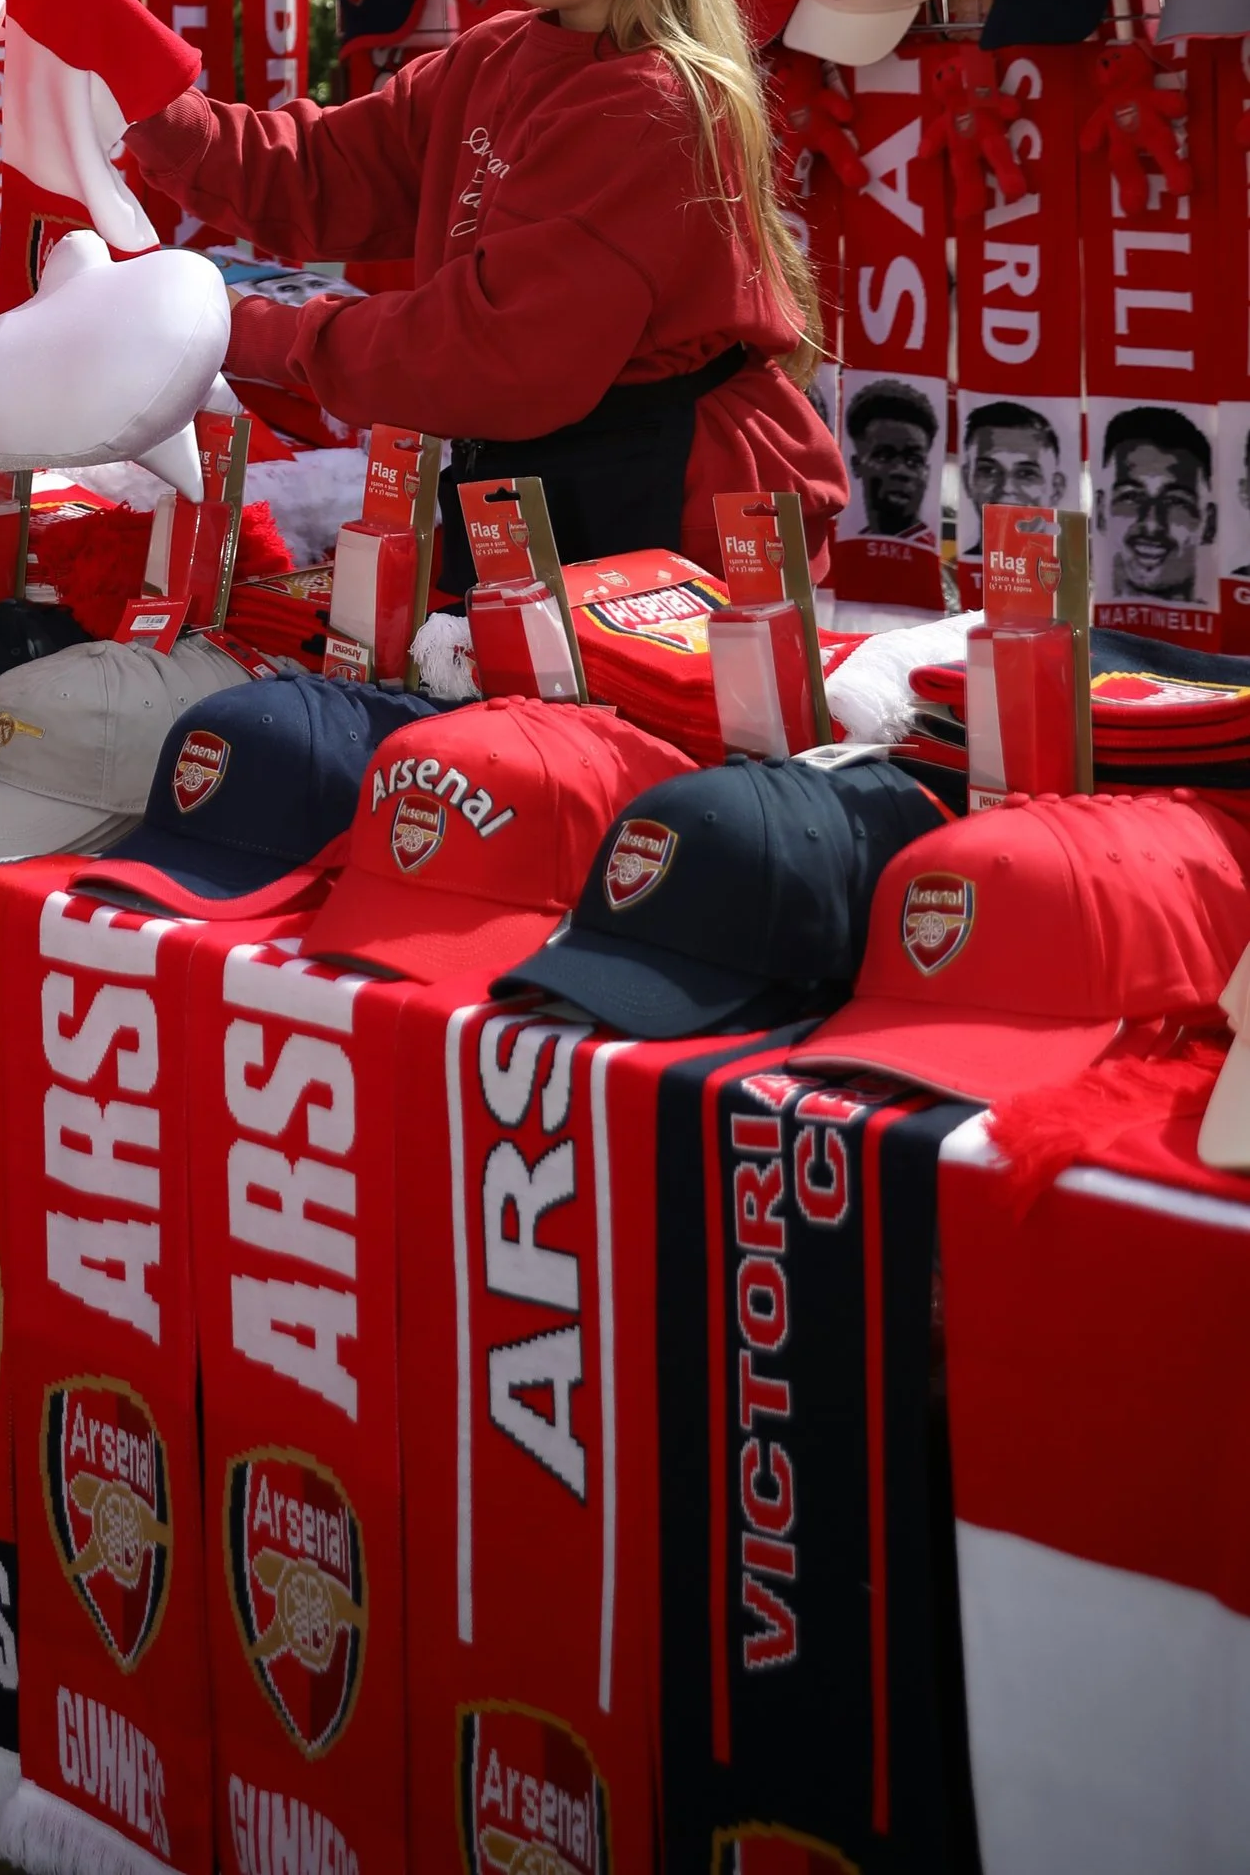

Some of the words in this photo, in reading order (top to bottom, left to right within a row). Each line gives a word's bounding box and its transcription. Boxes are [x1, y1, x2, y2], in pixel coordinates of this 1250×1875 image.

[371, 461, 399, 484] Flag
[470, 522, 500, 540] Flag
[725, 536, 756, 556] Flag
[866, 541, 913, 563] SAKA
[989, 551, 1027, 575] Flag
[1098, 606, 1214, 635] MARTINELLI
[332, 642, 362, 661] Arsenal
[183, 739, 222, 763] Arsenal
[371, 757, 517, 839] Arsenal
[399, 803, 438, 825] Arsenal
[619, 829, 666, 853] Arsenal
[908, 886, 963, 906] Arsenal
[69, 1403, 155, 1494] Arsenal
[253, 1475, 350, 1575] Arsenal
[479, 1748, 598, 1857] Arsenal
